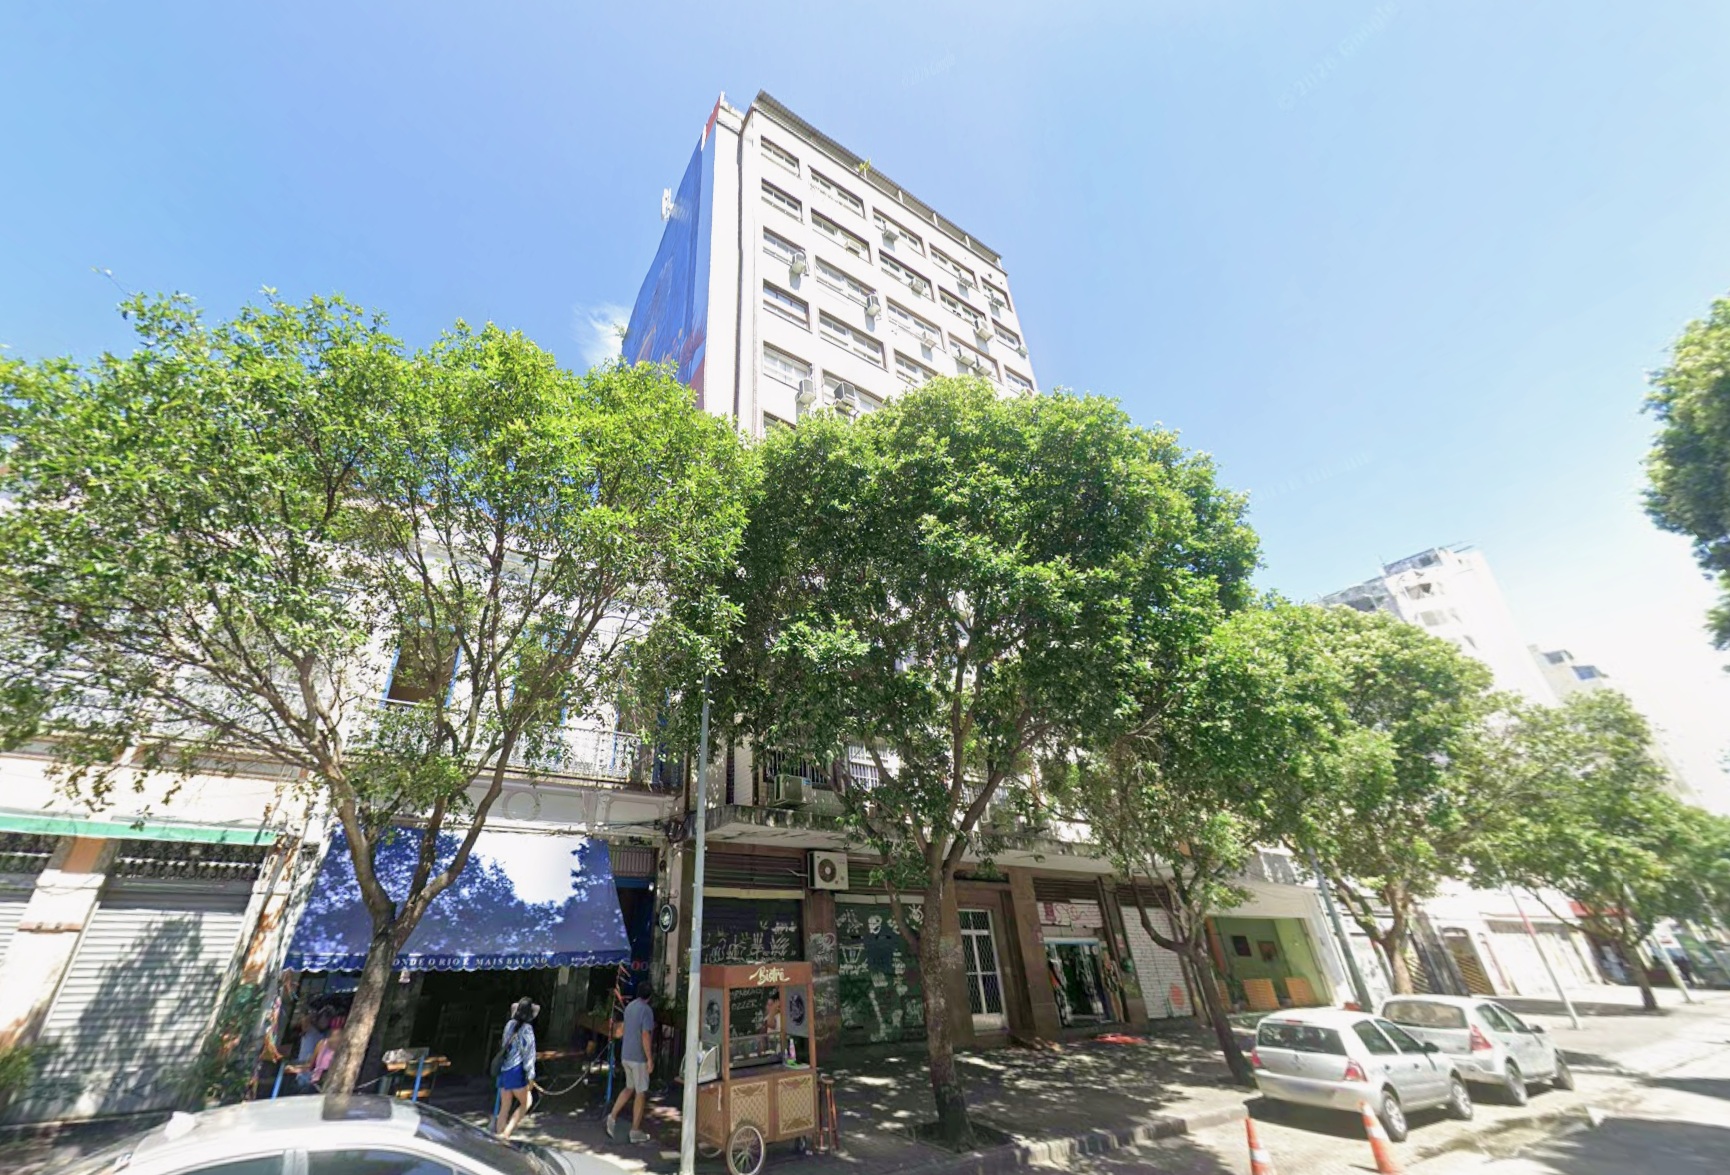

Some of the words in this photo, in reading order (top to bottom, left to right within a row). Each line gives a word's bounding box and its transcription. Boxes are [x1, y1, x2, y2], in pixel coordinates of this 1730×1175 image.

[393, 957, 425, 967] ONDE
[439, 957, 460, 966] RIO
[476, 957, 503, 966] MAIS
